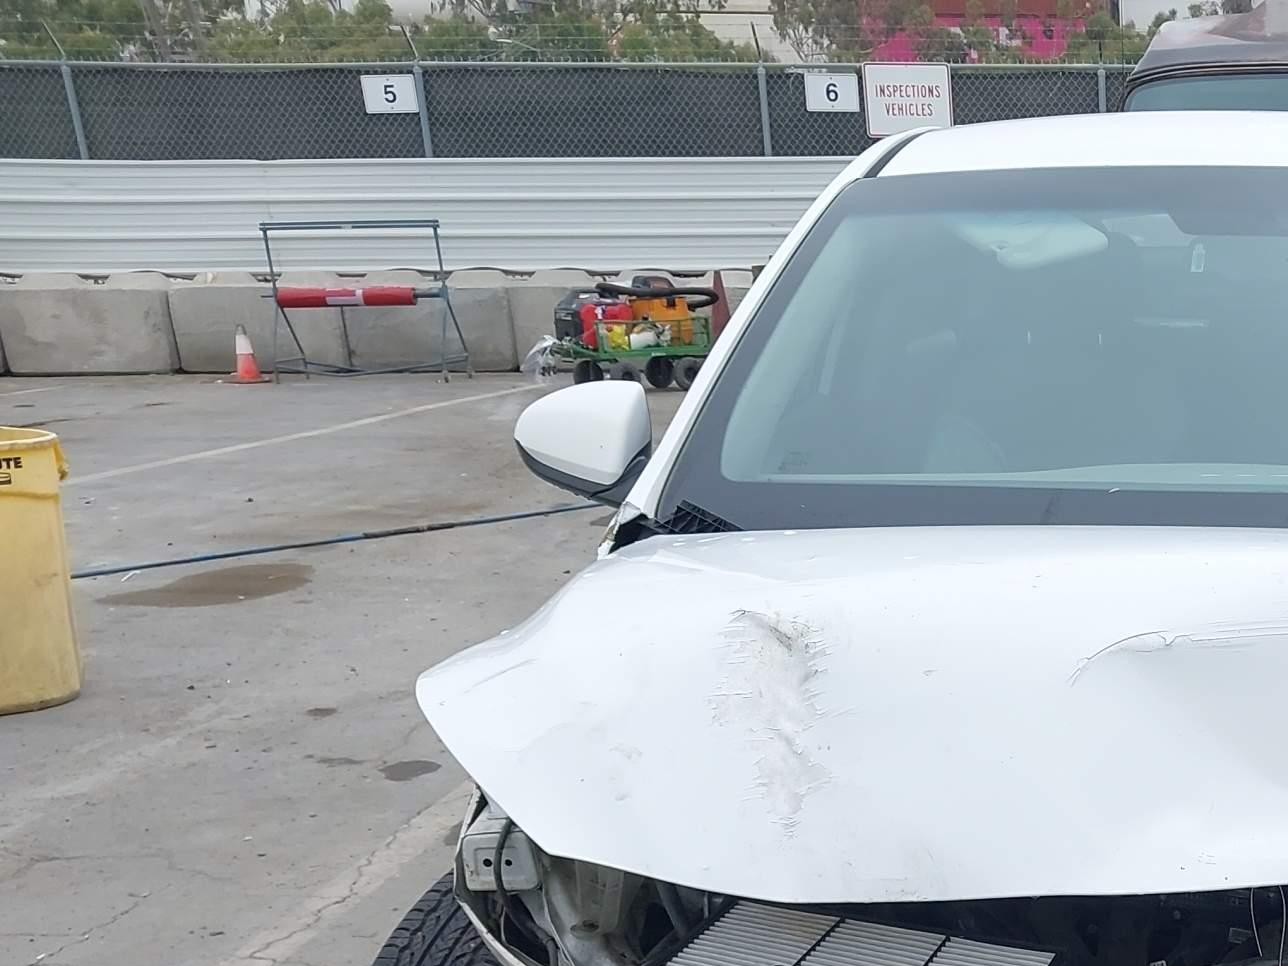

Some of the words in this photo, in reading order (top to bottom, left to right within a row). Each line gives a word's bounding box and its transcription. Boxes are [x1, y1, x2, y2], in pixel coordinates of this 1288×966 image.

[384, 85, 396, 103] 5
[825, 83, 838, 101] 6
[875, 85, 941, 98] INSPECTIONS
[885, 103, 933, 116] VEHICLES
[0, 457, 23, 469] TE
